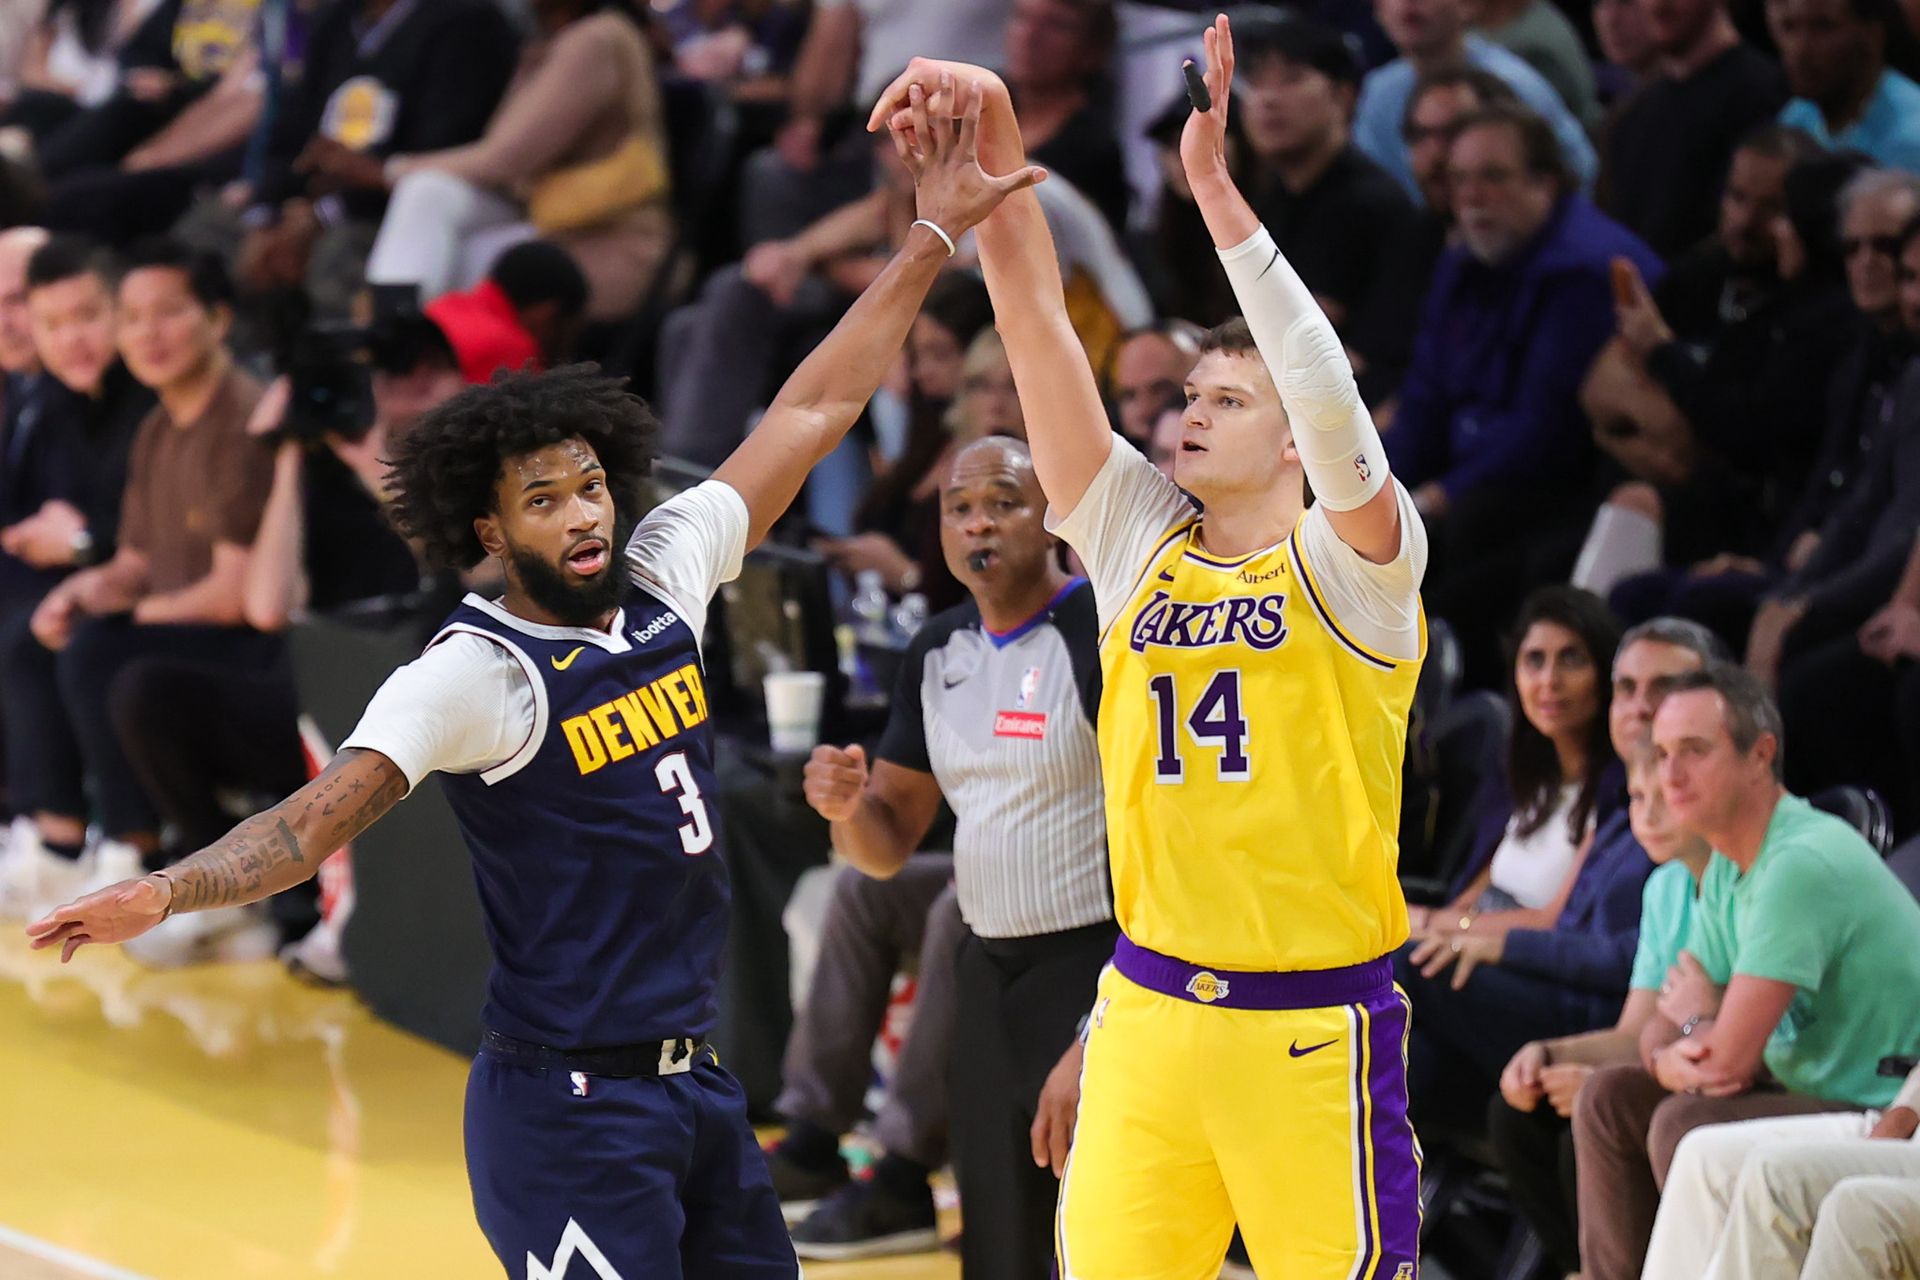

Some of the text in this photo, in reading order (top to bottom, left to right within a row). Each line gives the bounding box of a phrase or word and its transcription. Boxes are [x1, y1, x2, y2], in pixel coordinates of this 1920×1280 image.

[1236, 562, 1286, 584] Albert
[631, 611, 678, 644] ibotta
[1130, 590, 1288, 653] LAKERS
[560, 663, 708, 775] DENVER
[1149, 669, 1250, 783] 14
[654, 750, 714, 855] 3
